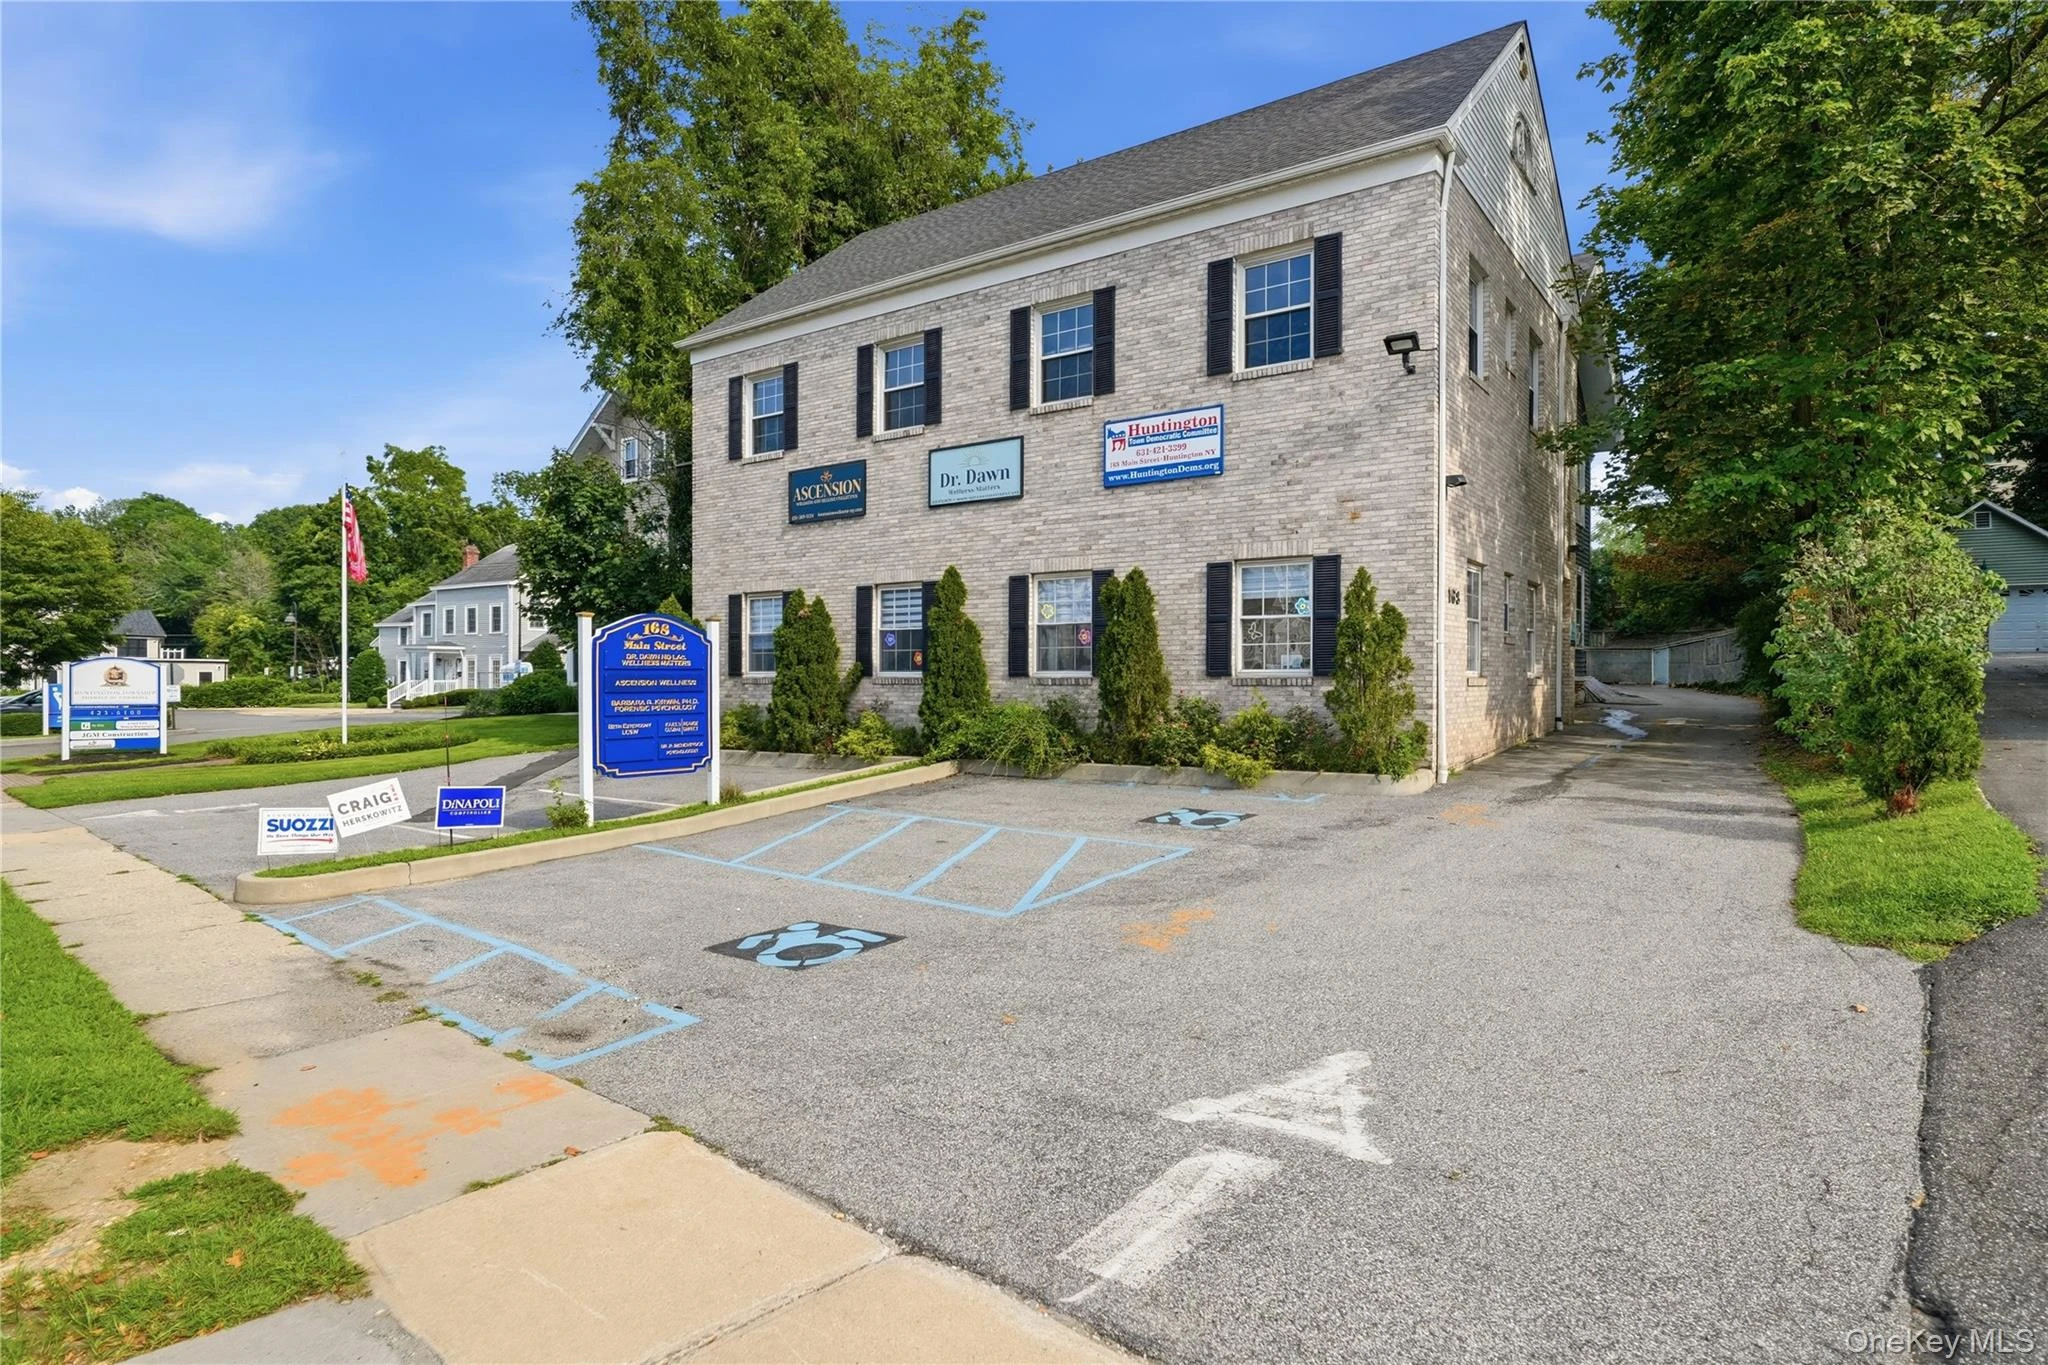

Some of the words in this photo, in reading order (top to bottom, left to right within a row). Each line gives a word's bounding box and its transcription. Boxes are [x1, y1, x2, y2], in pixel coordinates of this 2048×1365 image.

[1128, 415, 1218, 436] Huntington
[1146, 433, 1181, 443] Democratic
[1182, 428, 1218, 439] Committee
[1136, 443, 1187, 457] 631-421-3399
[1121, 459, 1139, 467] Main
[940, 472, 961, 488] Dr.
[966, 467, 1010, 485] Dawn
[1108, 462, 1220, 482] www.HuntingtonDems.org
[793, 478, 862, 503] ASCENSION
[948, 487, 975, 496] Wellness
[976, 485, 1001, 493] Matters
[642, 621, 671, 636] 168
[624, 640, 650, 650] Main
[654, 640, 687, 650] Street
[611, 699, 646, 707] BARBARA
[614, 705, 650, 713] FORENSIC
[651, 704, 697, 712] PSYCHOLOGY
[337, 791, 393, 815] CRAIG
[342, 805, 403, 828] HERSKOWITZ
[266, 817, 334, 833] SUOZZI
